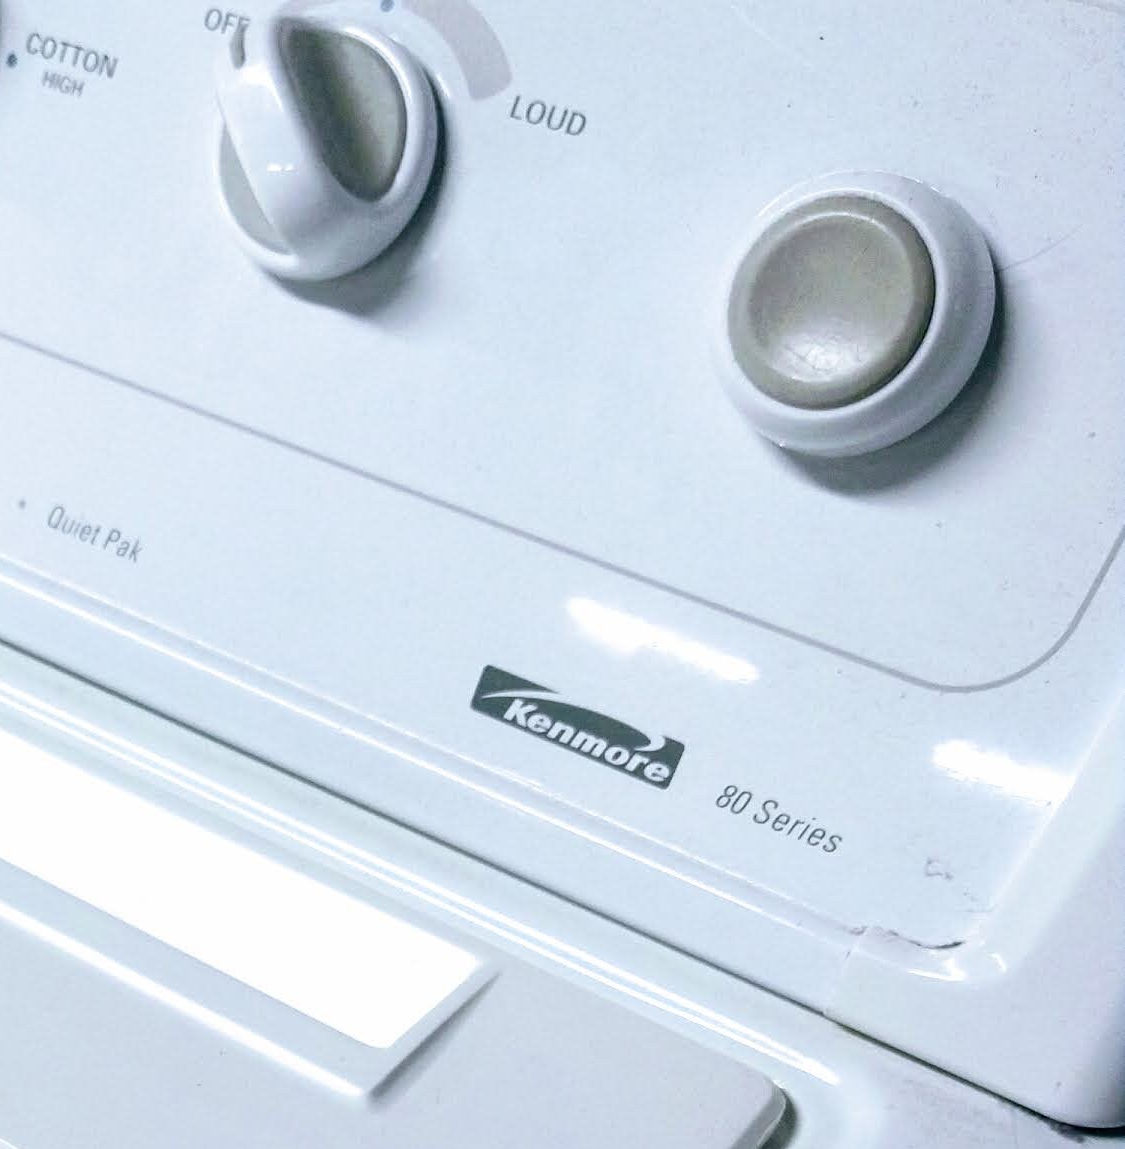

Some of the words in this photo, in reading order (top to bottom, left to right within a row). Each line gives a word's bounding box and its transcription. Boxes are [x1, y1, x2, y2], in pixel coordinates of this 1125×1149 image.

[26, 33, 119, 79] COTTON
[42, 71, 85, 97] HIGH
[509, 94, 587, 137] LOUD
[46, 505, 102, 547] Quiet
[103, 528, 144, 564] Pak
[502, 698, 671, 785] Kenmore
[715, 784, 752, 816] 80
[753, 799, 844, 854] Series
